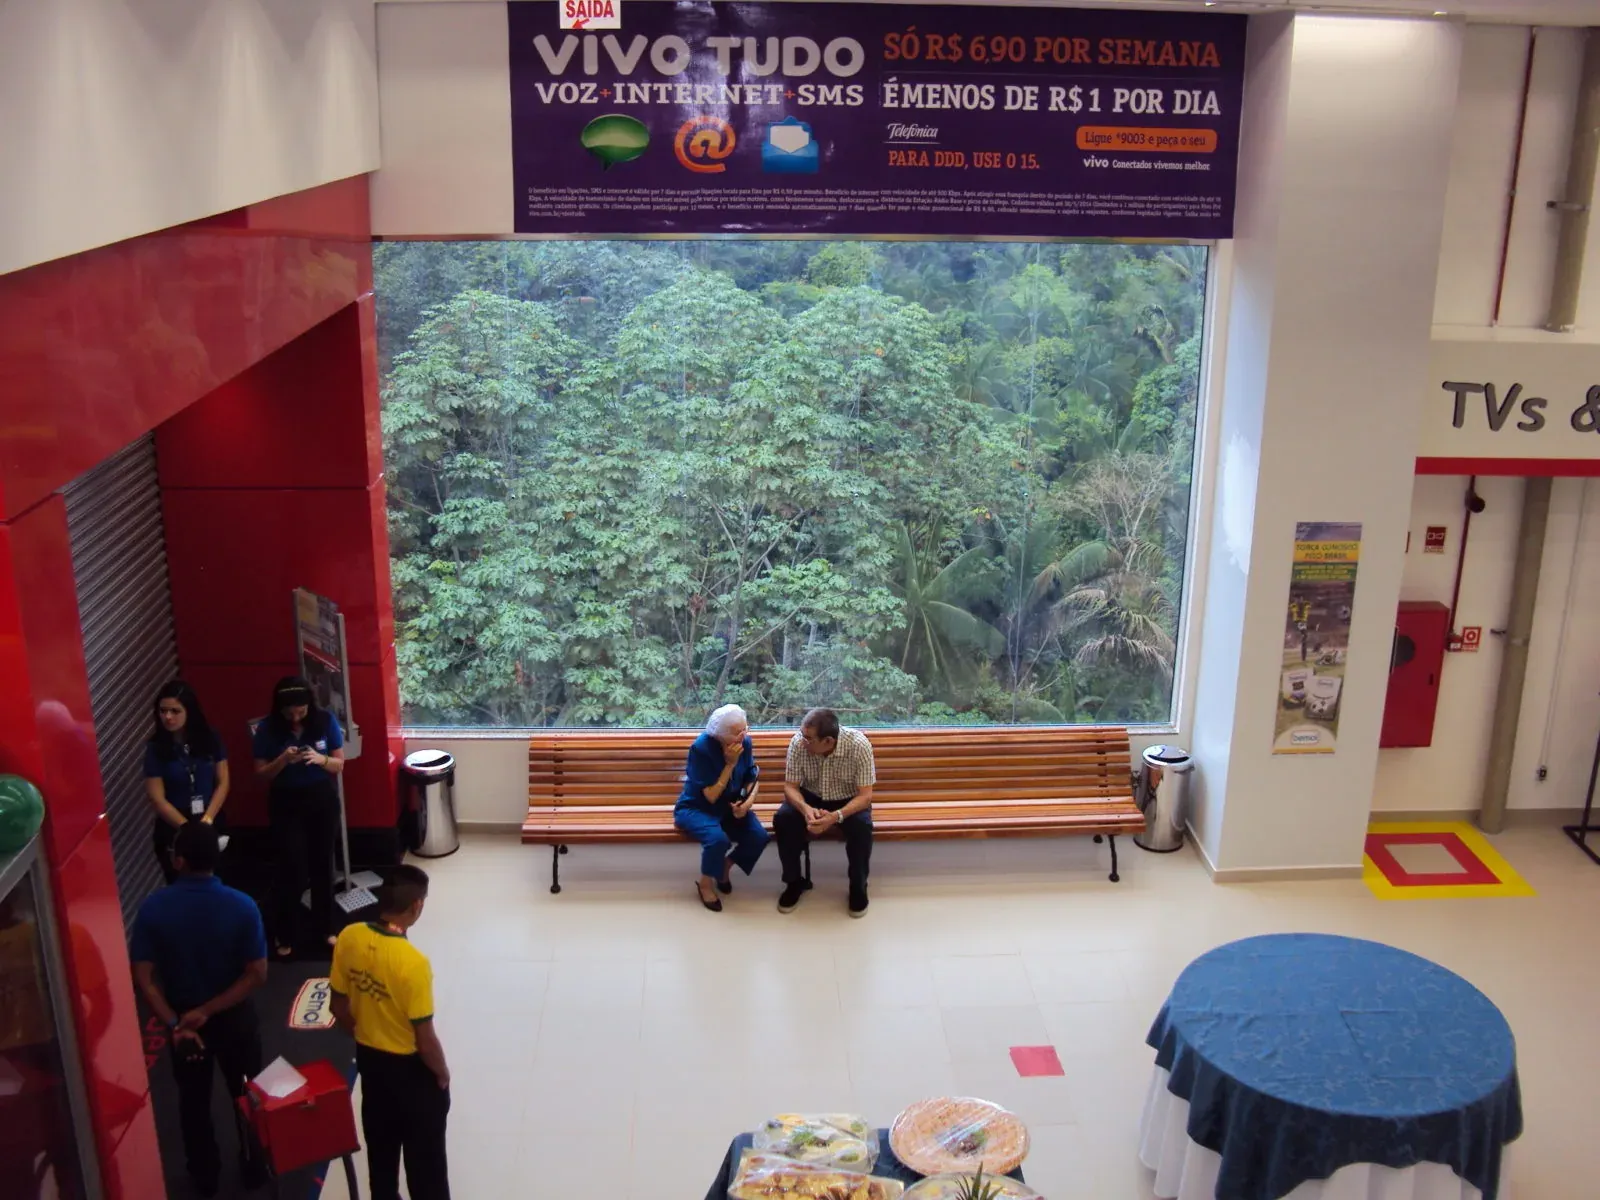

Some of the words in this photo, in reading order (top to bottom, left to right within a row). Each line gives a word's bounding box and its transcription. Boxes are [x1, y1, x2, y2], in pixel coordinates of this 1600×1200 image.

[706, 36, 865, 77] TUDO
[883, 25, 920, 60] SÓ
[925, 32, 963, 62] R$
[969, 35, 1026, 65] 6,90
[1033, 36, 1092, 64] POR
[1098, 37, 1221, 68] SEMANA
[1004, 85, 1039, 111] DE
[1112, 88, 1165, 114] POR
[1172, 89, 1221, 115] DIA
[1085, 131, 1112, 147] Ligue
[1148, 135, 1154, 144] e
[1156, 135, 1178, 147] peça
[1181, 136, 1187, 146] o
[1189, 136, 1206, 146] seu
[888, 150, 930, 167] PARA
[934, 151, 969, 170] DDD,
[973, 151, 1001, 169] USE
[1020, 153, 1040, 169] 15.
[1083, 155, 1109, 168] vivo
[1112, 159, 1152, 170] Conectados
[1153, 160, 1183, 170] vivemos
[1441, 380, 1548, 432] TVs
